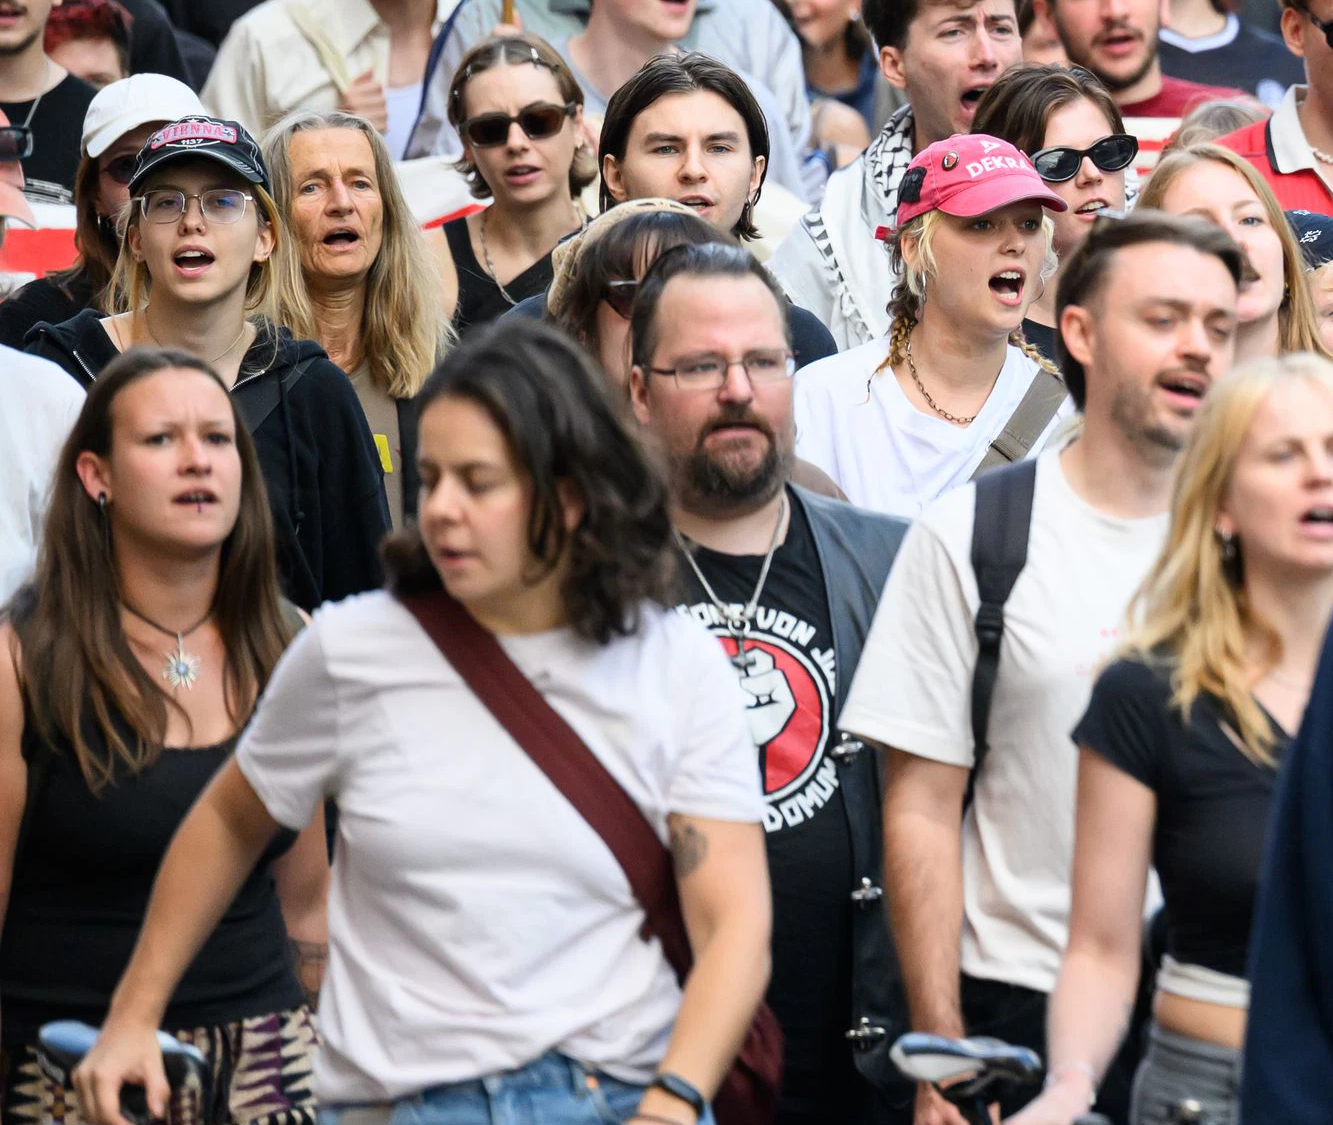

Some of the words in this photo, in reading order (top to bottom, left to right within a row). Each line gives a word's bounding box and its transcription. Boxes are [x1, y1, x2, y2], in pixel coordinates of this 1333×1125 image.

[162, 122, 223, 141] VIENNA
[965, 155, 1038, 179] DEKRA
[756, 605, 817, 648] VON
